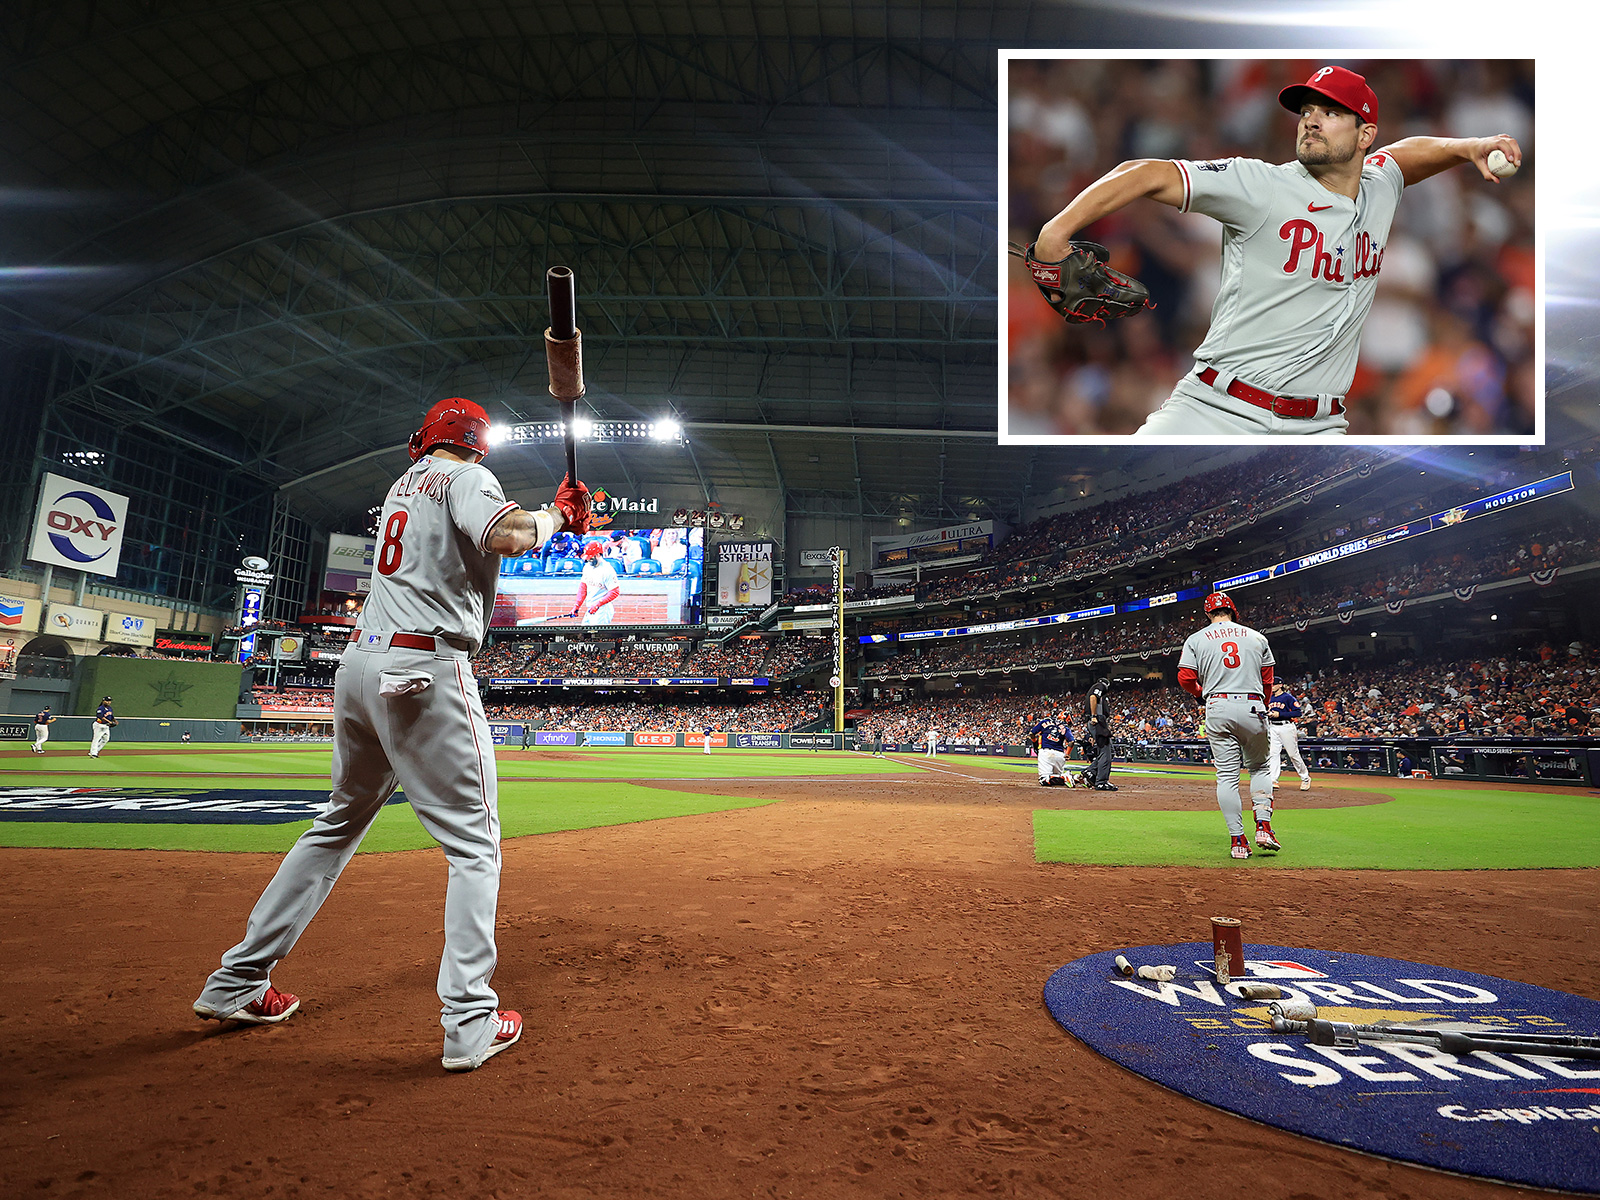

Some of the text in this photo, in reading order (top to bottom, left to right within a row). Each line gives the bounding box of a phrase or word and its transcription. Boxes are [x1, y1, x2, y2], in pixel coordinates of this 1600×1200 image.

[1279, 219, 1384, 283] Phillie
[610, 497, 658, 512] Maid
[1485, 488, 1536, 510] HOUSTON
[47, 510, 117, 541] OXY
[948, 526, 983, 539] ULTRA
[377, 511, 408, 576] 8
[750, 543, 763, 553] TU
[803, 552, 826, 561] Texas
[1310, 549, 1339, 565] WORLD
[1339, 537, 1368, 557] SERIES
[234, 569, 275, 580] Gallagher
[237, 576, 270, 585] INSURANCE
[1219, 574, 1260, 589] PHILADELPHIA
[1149, 592, 1178, 607] 2022
[76, 619, 99, 627] QUANTA
[832, 606, 840, 629] THA
[1204, 627, 1247, 641] HARPER
[155, 638, 212, 650] Budweiser
[567, 643, 596, 652] CHEVY
[633, 643, 680, 652] SILVERADO
[1221, 641, 1241, 669] 3
[542, 733, 569, 744] xfinity
[1109, 979, 1498, 1007] WORLD
